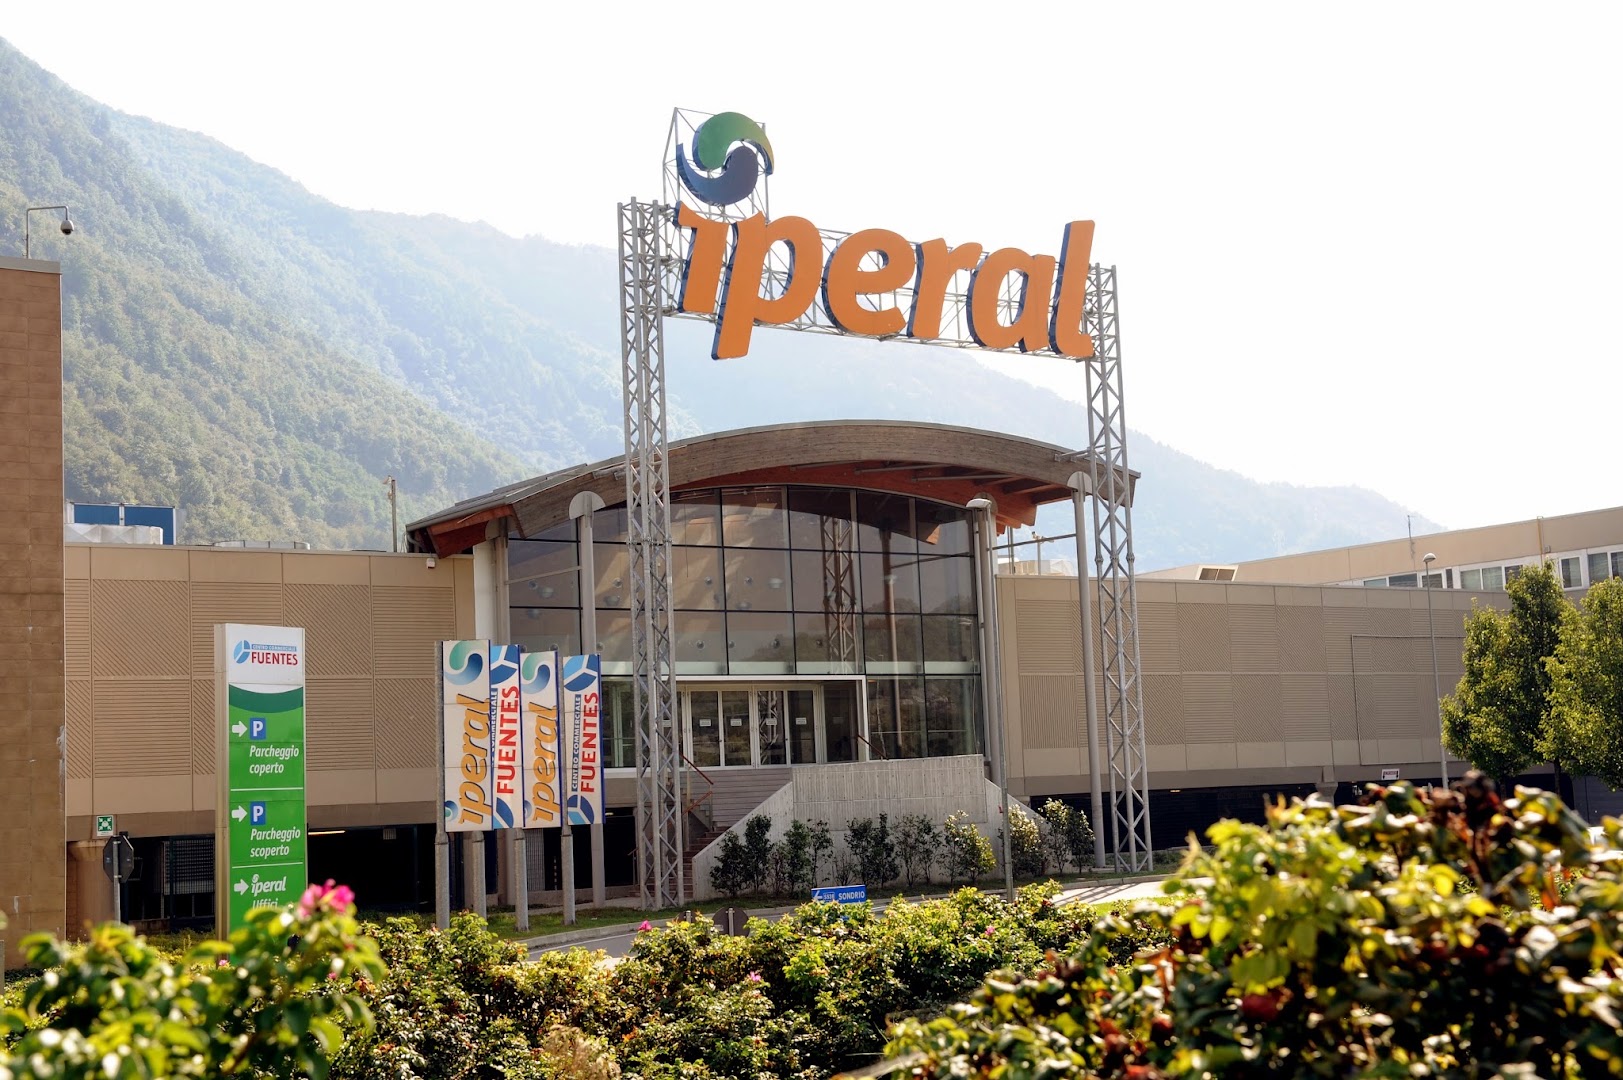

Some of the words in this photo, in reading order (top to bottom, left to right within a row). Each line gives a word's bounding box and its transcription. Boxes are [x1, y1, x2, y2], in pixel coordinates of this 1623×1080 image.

[676, 200, 1096, 361] iperal
[251, 651, 298, 666] FUENTES
[252, 720, 264, 737] P
[573, 697, 581, 755] COMMERCIALE
[496, 685, 520, 795] FUENTES
[580, 692, 599, 793] FUENTES
[249, 744, 300, 760] Parcheggio
[456, 693, 492, 825] iperal
[249, 762, 285, 776] coperto
[528, 701, 560, 822] iperal
[253, 805, 264, 822] P
[250, 826, 301, 842] Parcheggio
[250, 844, 290, 860] scoperto
[251, 874, 287, 897] iperal
[838, 891, 865, 900] SONDRIO
